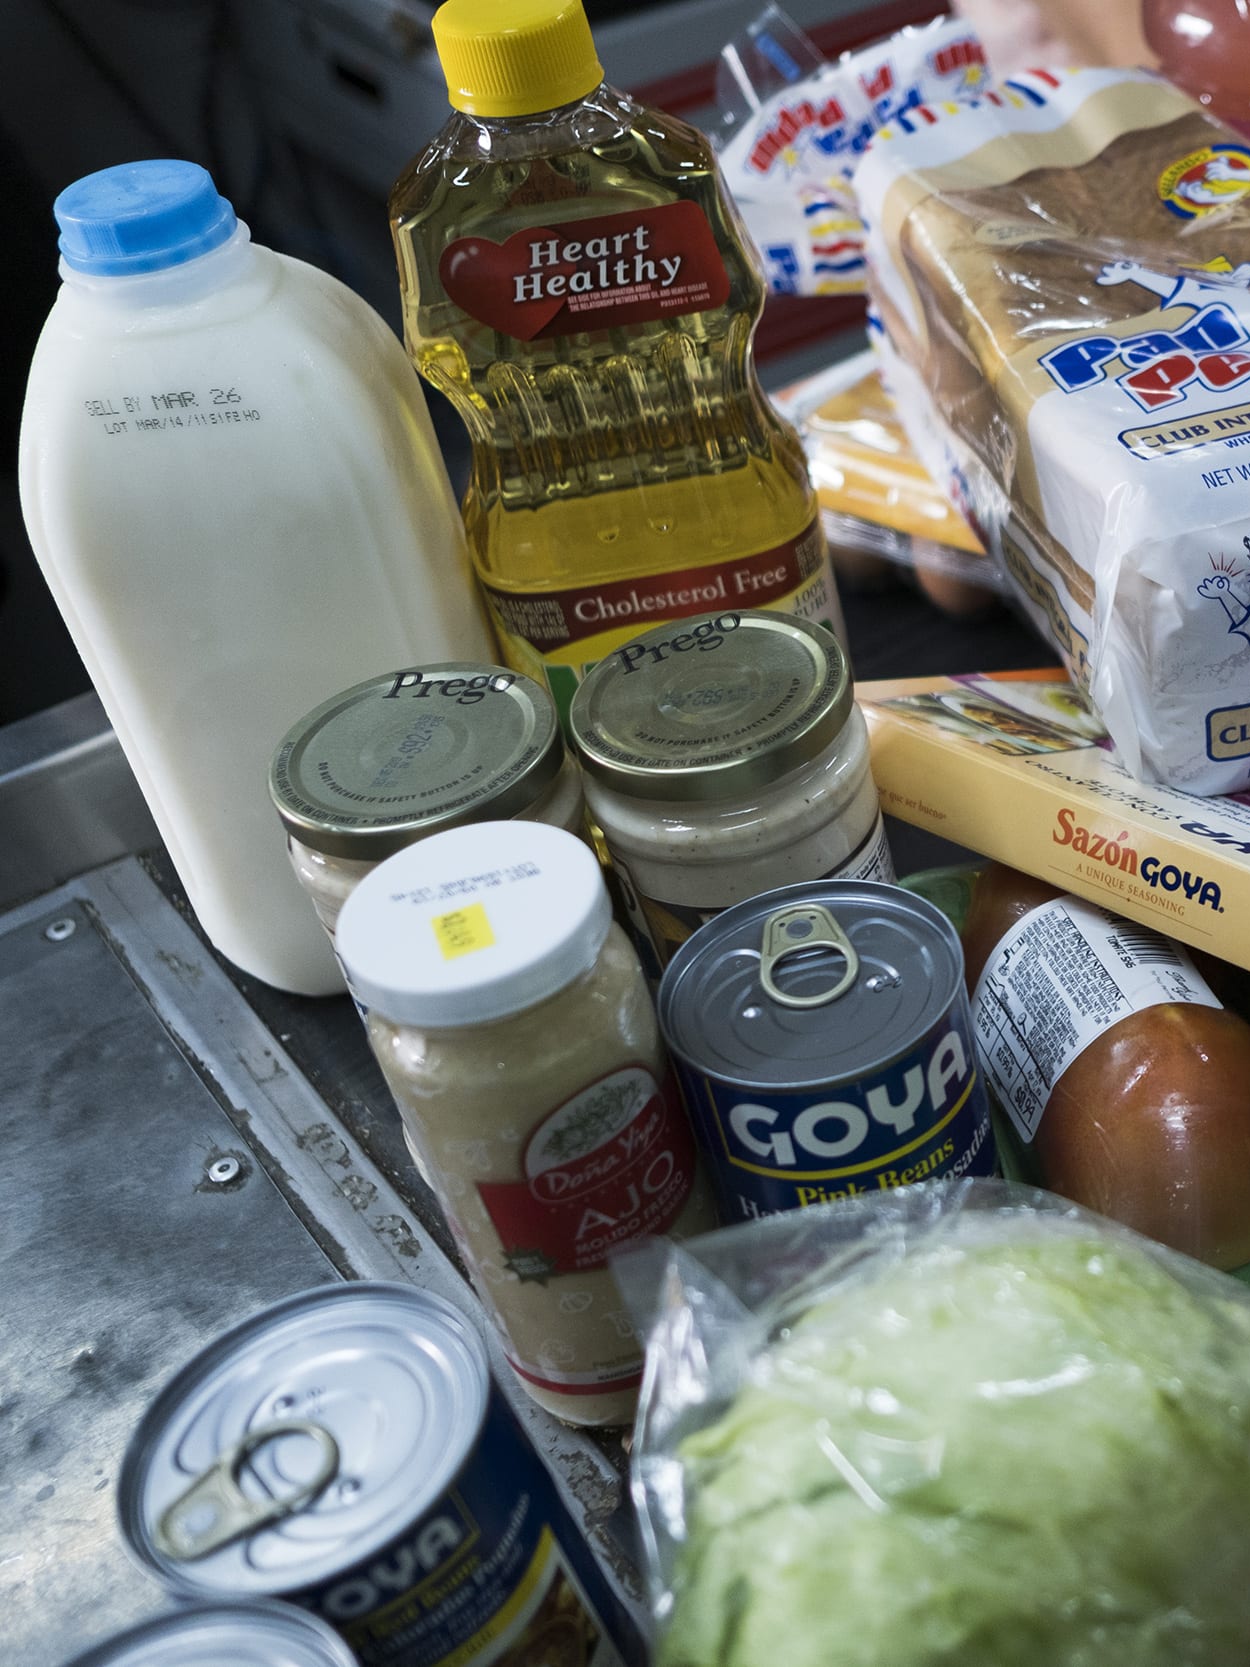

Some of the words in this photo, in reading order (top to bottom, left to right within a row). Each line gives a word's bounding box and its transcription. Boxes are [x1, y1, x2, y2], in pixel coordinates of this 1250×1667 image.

[529, 225, 650, 270] Heart
[513, 255, 682, 303] Healthy
[1048, 309, 1241, 389] Pan
[84, 398, 120, 418] SELL
[123, 396, 141, 415] BY
[150, 390, 198, 411] MAR
[209, 386, 242, 405] 26
[104, 420, 128, 435] LOT
[1141, 425, 1210, 448] CLUB
[1201, 468, 1235, 488] NET
[574, 575, 726, 624] Cholesterol
[735, 562, 788, 595] Free
[614, 612, 741, 675] Prego
[383, 671, 516, 704] Prego
[618, 751, 635, 763] USE
[635, 755, 649, 766] BY
[672, 758, 686, 767] ON
[689, 749, 743, 767] CONTAINER
[756, 721, 800, 746] PROMPTLY
[667, 736, 718, 746] PURCHASE
[734, 717, 769, 735] SAFETY
[373, 811, 424, 825] PROMPTLY
[487, 772, 512, 791] AFTER
[420, 779, 460, 797] BUTTON
[460, 774, 471, 782] IS
[1052, 807, 1138, 876] Sazón
[1140, 857, 1223, 912] GOYA
[1076, 863, 1084, 872] A
[1085, 865, 1126, 891] UNIQUE
[1127, 884, 1185, 916] SEASONING
[1070, 928, 1096, 961] HANDLING
[1089, 956, 1124, 1003] INSTRUCTIONS
[729, 1031, 968, 1166] GOYA
[876, 1137, 955, 1191] Beans
[575, 1150, 674, 1240] AJO
[575, 1217, 641, 1254] MOLIDO
